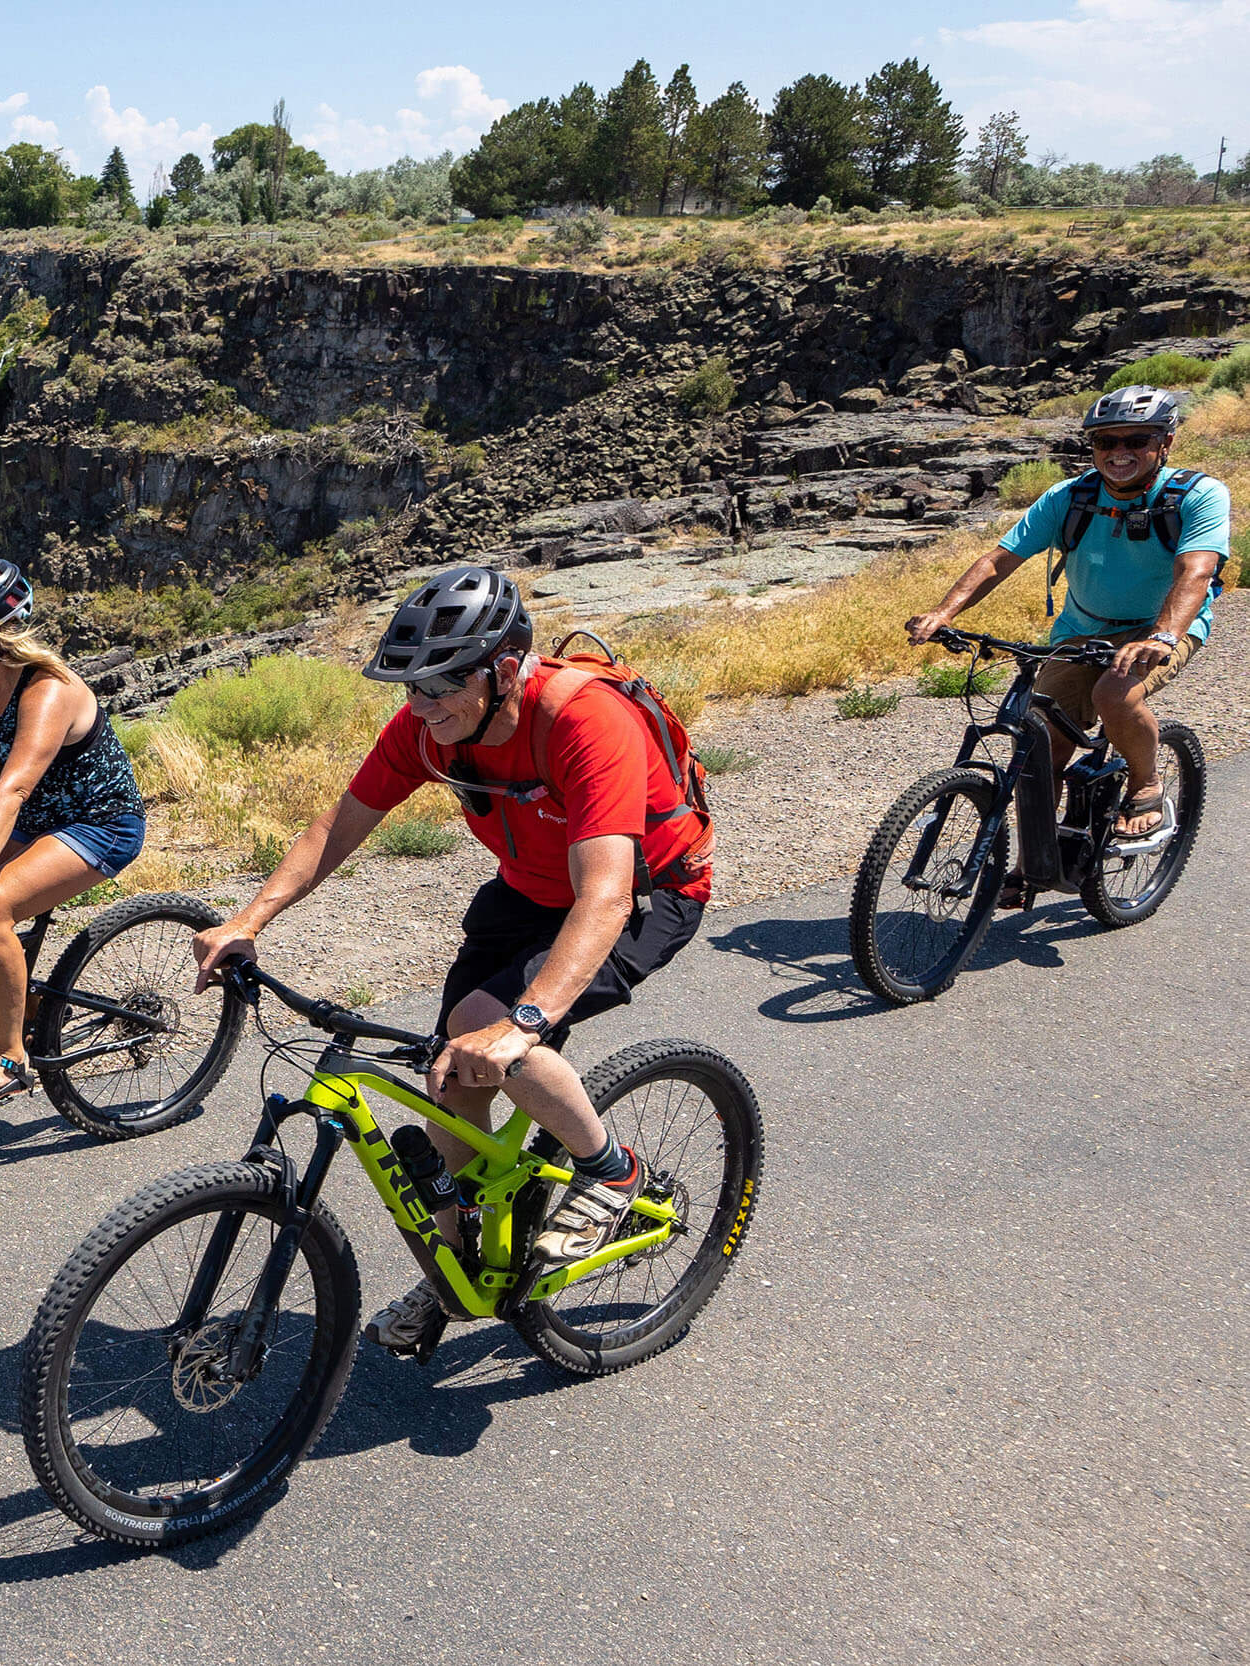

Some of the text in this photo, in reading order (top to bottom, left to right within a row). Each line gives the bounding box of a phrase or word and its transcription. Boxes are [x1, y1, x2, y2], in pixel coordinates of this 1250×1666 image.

[362, 1114, 449, 1258] TREK
[722, 1178, 754, 1256] MAXXIS
[104, 1507, 163, 1532] BONTRAGER
